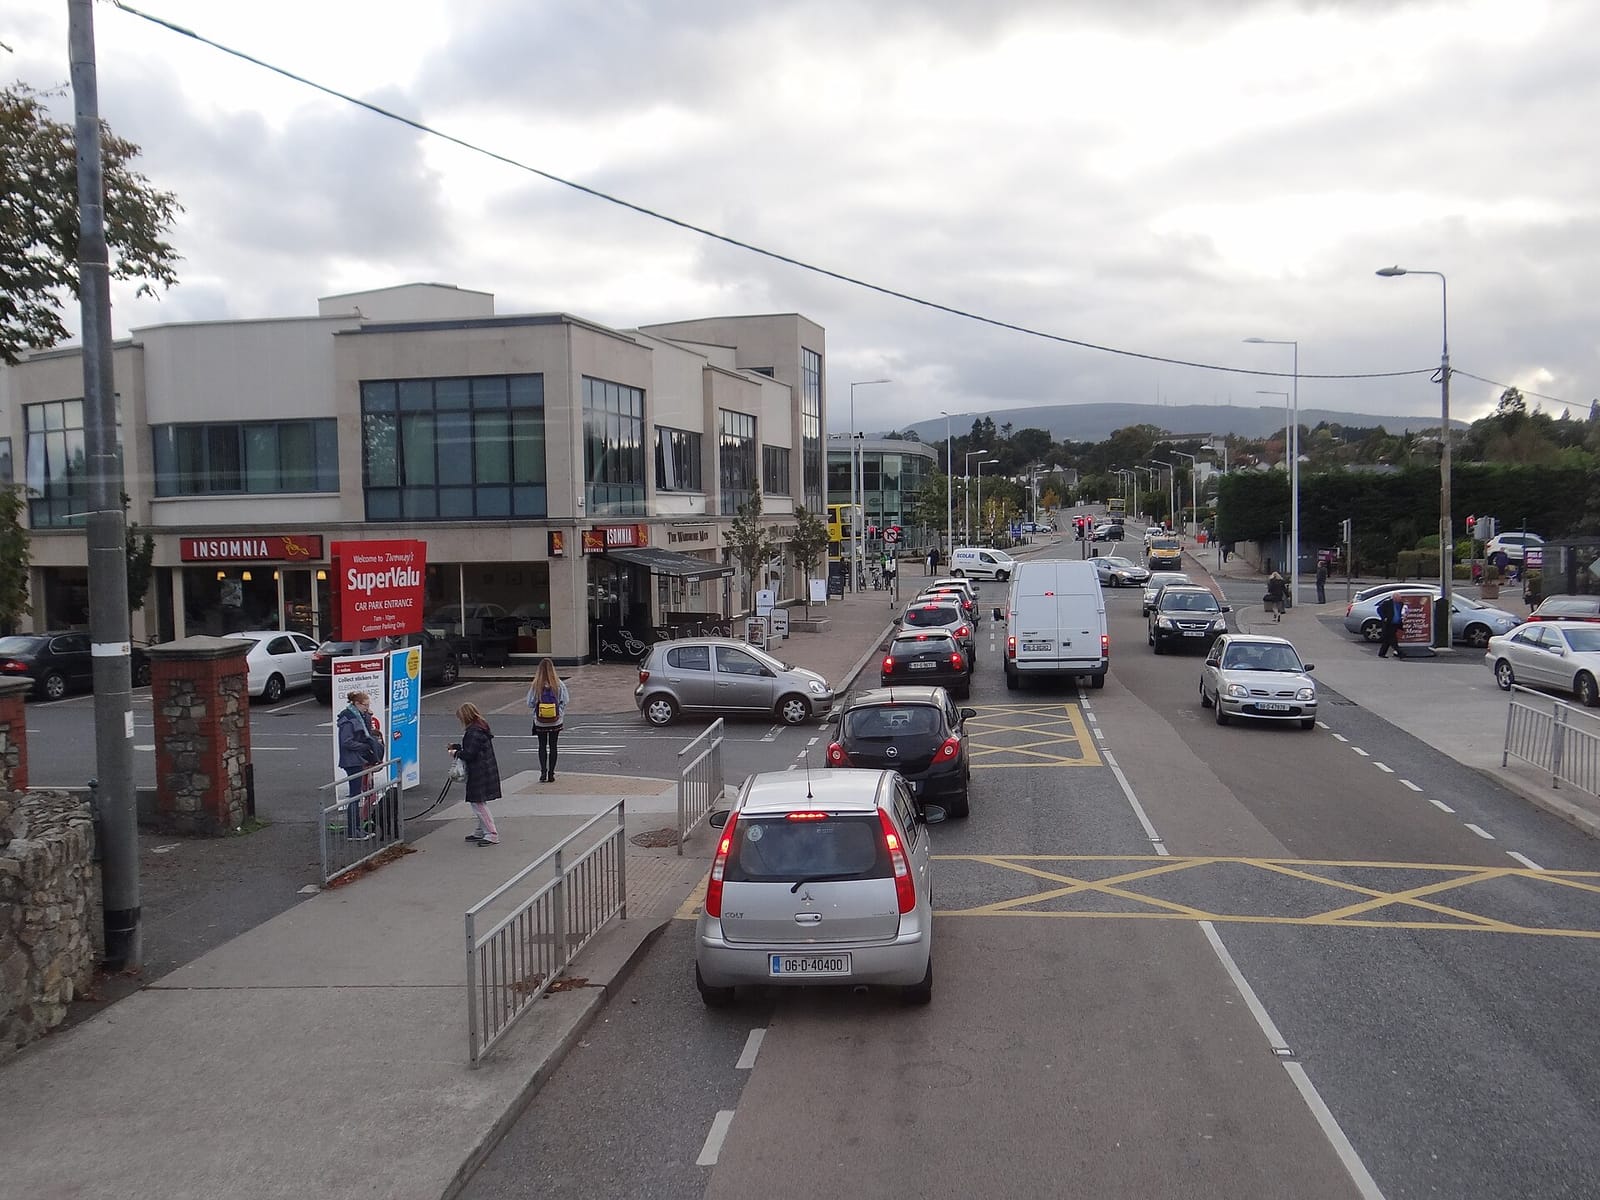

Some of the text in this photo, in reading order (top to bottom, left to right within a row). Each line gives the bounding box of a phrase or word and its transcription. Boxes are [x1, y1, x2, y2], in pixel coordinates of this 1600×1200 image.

[193, 540, 268, 557] INSOMNIA
[353, 554, 377, 563] Welcome
[347, 566, 420, 596] SuperValu
[354, 598, 413, 612] CAR PARK ENTRANCE
[382, 622, 396, 630] Parking
[393, 678, 409, 690] FREE
[393, 688, 409, 700] €20
[785, 958, 843, 972] 06-D-40400
